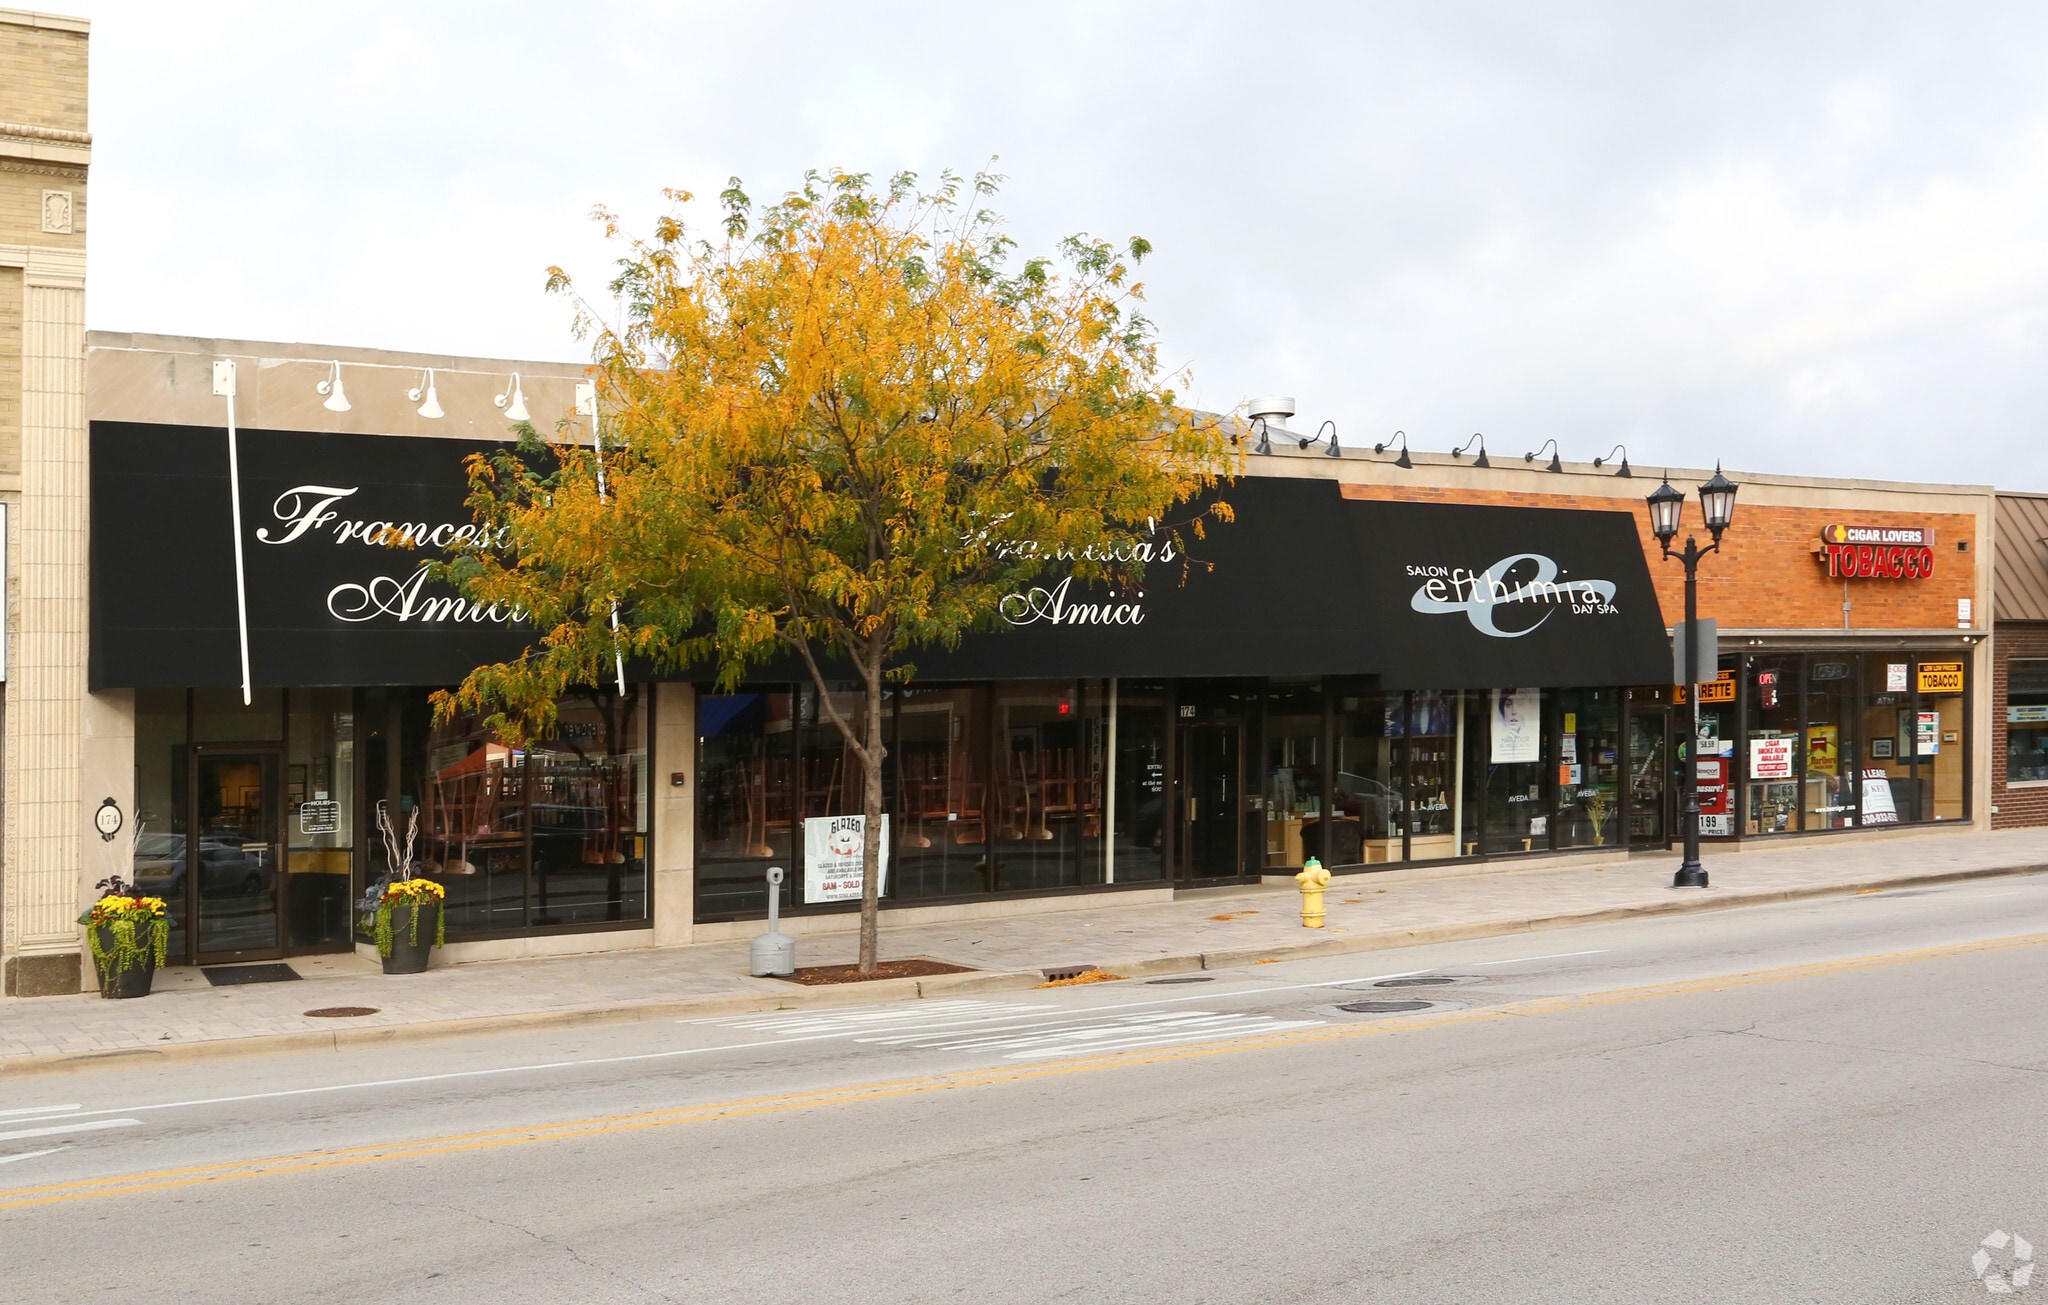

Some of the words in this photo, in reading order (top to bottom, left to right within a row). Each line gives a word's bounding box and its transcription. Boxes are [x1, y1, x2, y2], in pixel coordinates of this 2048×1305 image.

[1848, 529, 1880, 541] CIGAR
[1883, 530, 1922, 542] LOVERS
[1826, 545, 1935, 578] TOBACCO
[1406, 565, 1448, 577] SALON
[1426, 568, 1600, 604] efthimia
[999, 576, 1145, 624] Amici
[1572, 604, 1593, 614] DAY
[1597, 604, 1618, 614] SPA
[1759, 673, 1778, 685] OPEN
[1923, 675, 1959, 687] TOBACCO
[1877, 697, 1895, 705] ATM
[1867, 769, 1887, 779] LEASE
[1508, 794, 1529, 802] AVEDA
[1577, 789, 1598, 798] AVEDA
[1427, 803, 1449, 811] AVEDA
[101, 814, 118, 825] 174
[831, 818, 861, 834] GLAZED
[843, 880, 860, 889] SOLD
